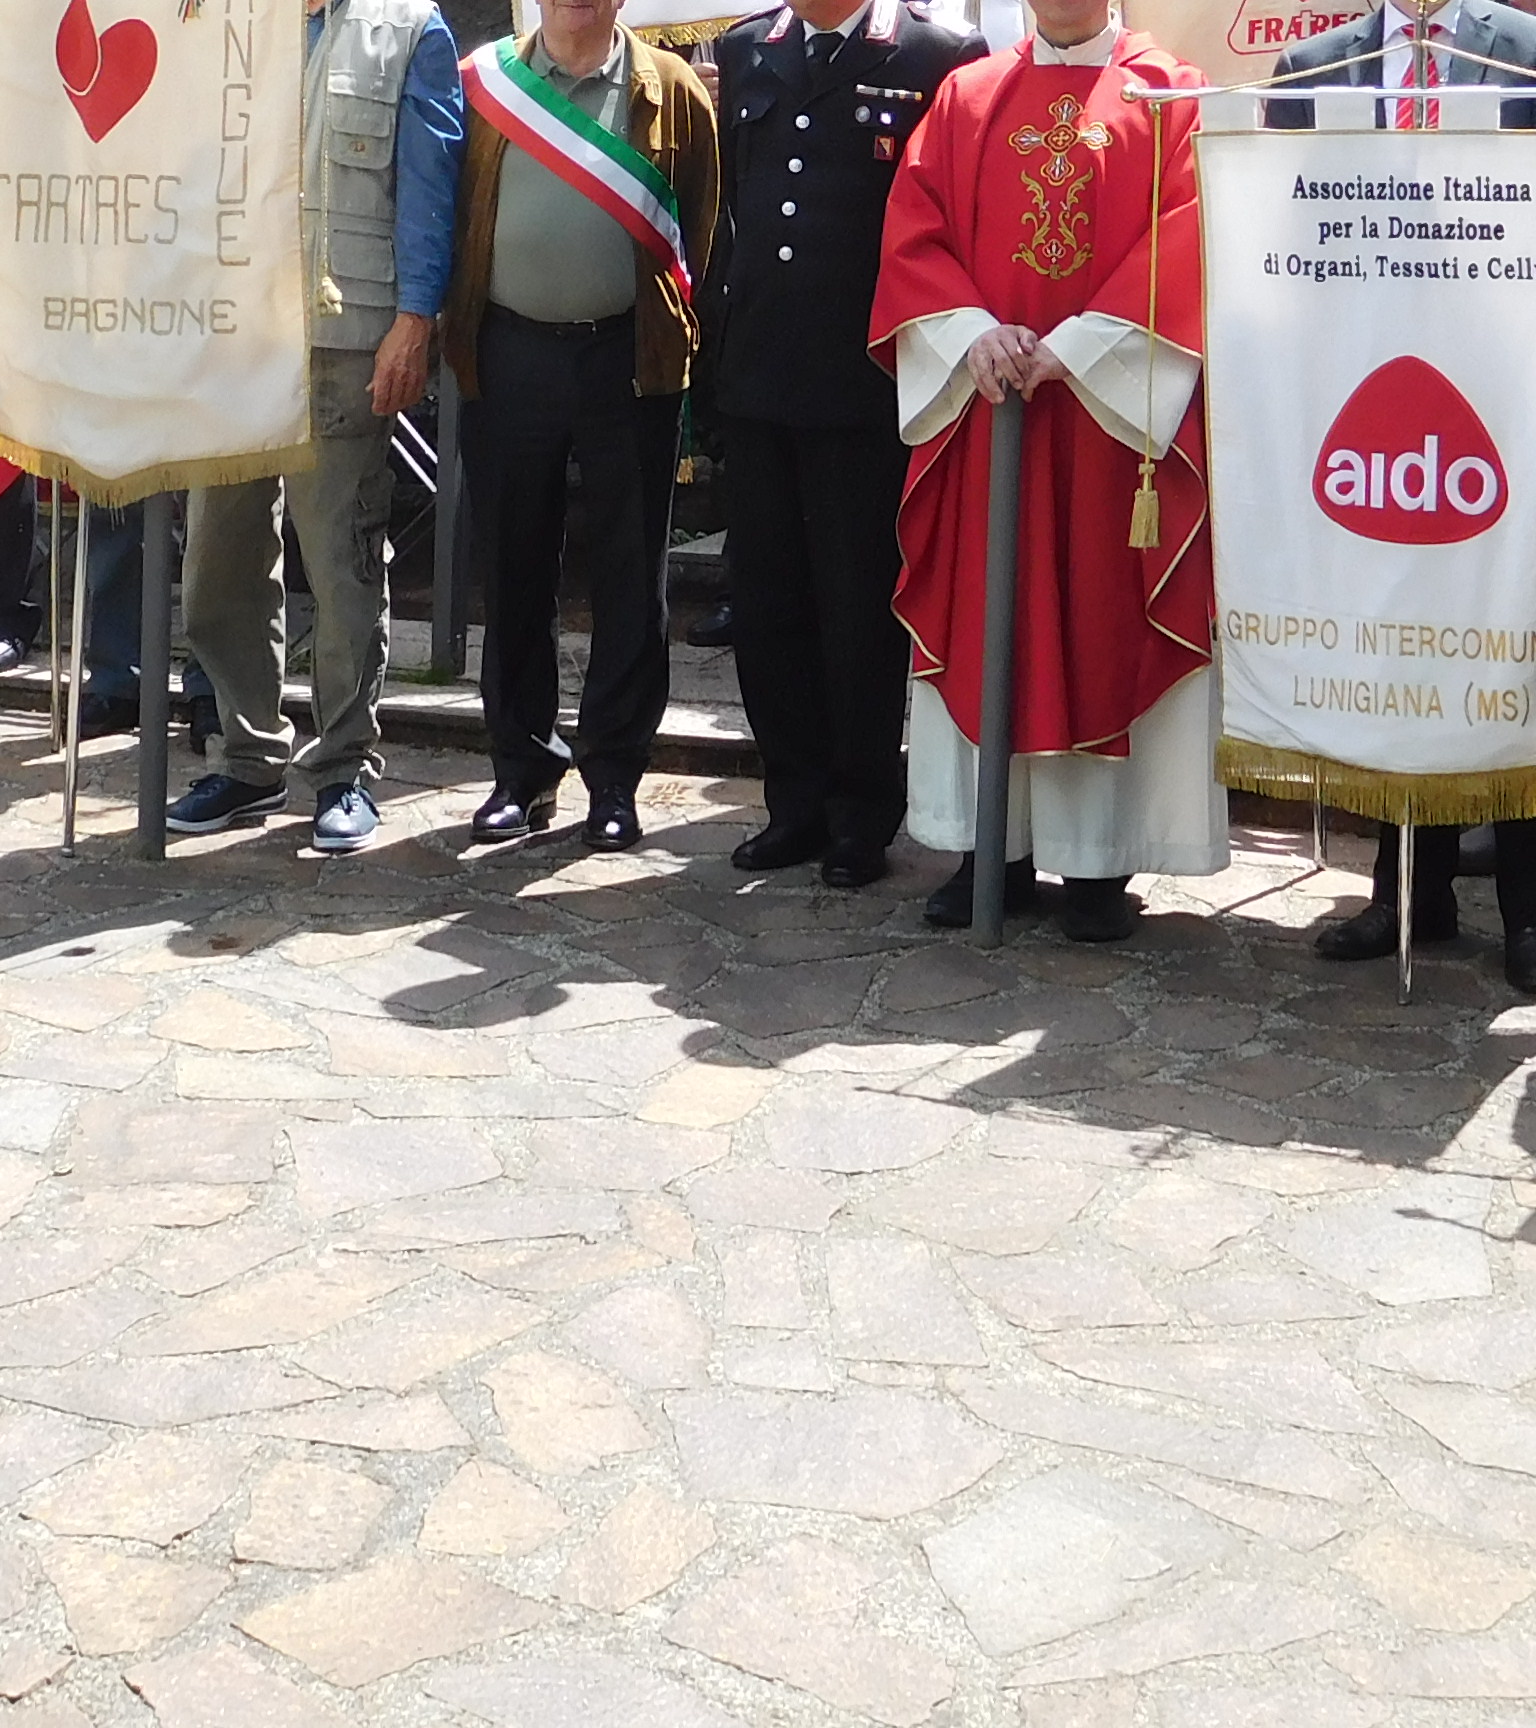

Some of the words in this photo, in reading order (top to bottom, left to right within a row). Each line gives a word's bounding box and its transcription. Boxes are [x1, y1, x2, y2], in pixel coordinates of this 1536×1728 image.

[1247, 9, 1365, 45] FRATRE
[1292, 174, 1434, 201] Associazione
[1443, 176, 1532, 202] Italiana
[1318, 221, 1353, 245] per
[1361, 215, 1380, 239] la
[1388, 216, 1505, 241] Donazione
[1264, 252, 1279, 275] di
[1286, 253, 1368, 282] Organi,
[1375, 255, 1460, 279] Tessuti
[1467, 262, 1479, 279] e
[43, 297, 237, 336] BAGNONE
[1323, 433, 1498, 516] aido
[1227, 608, 1339, 651] GRUPPO
[1292, 675, 1444, 720] LUNIGIANA
[1464, 680, 1530, 727] (MS)
